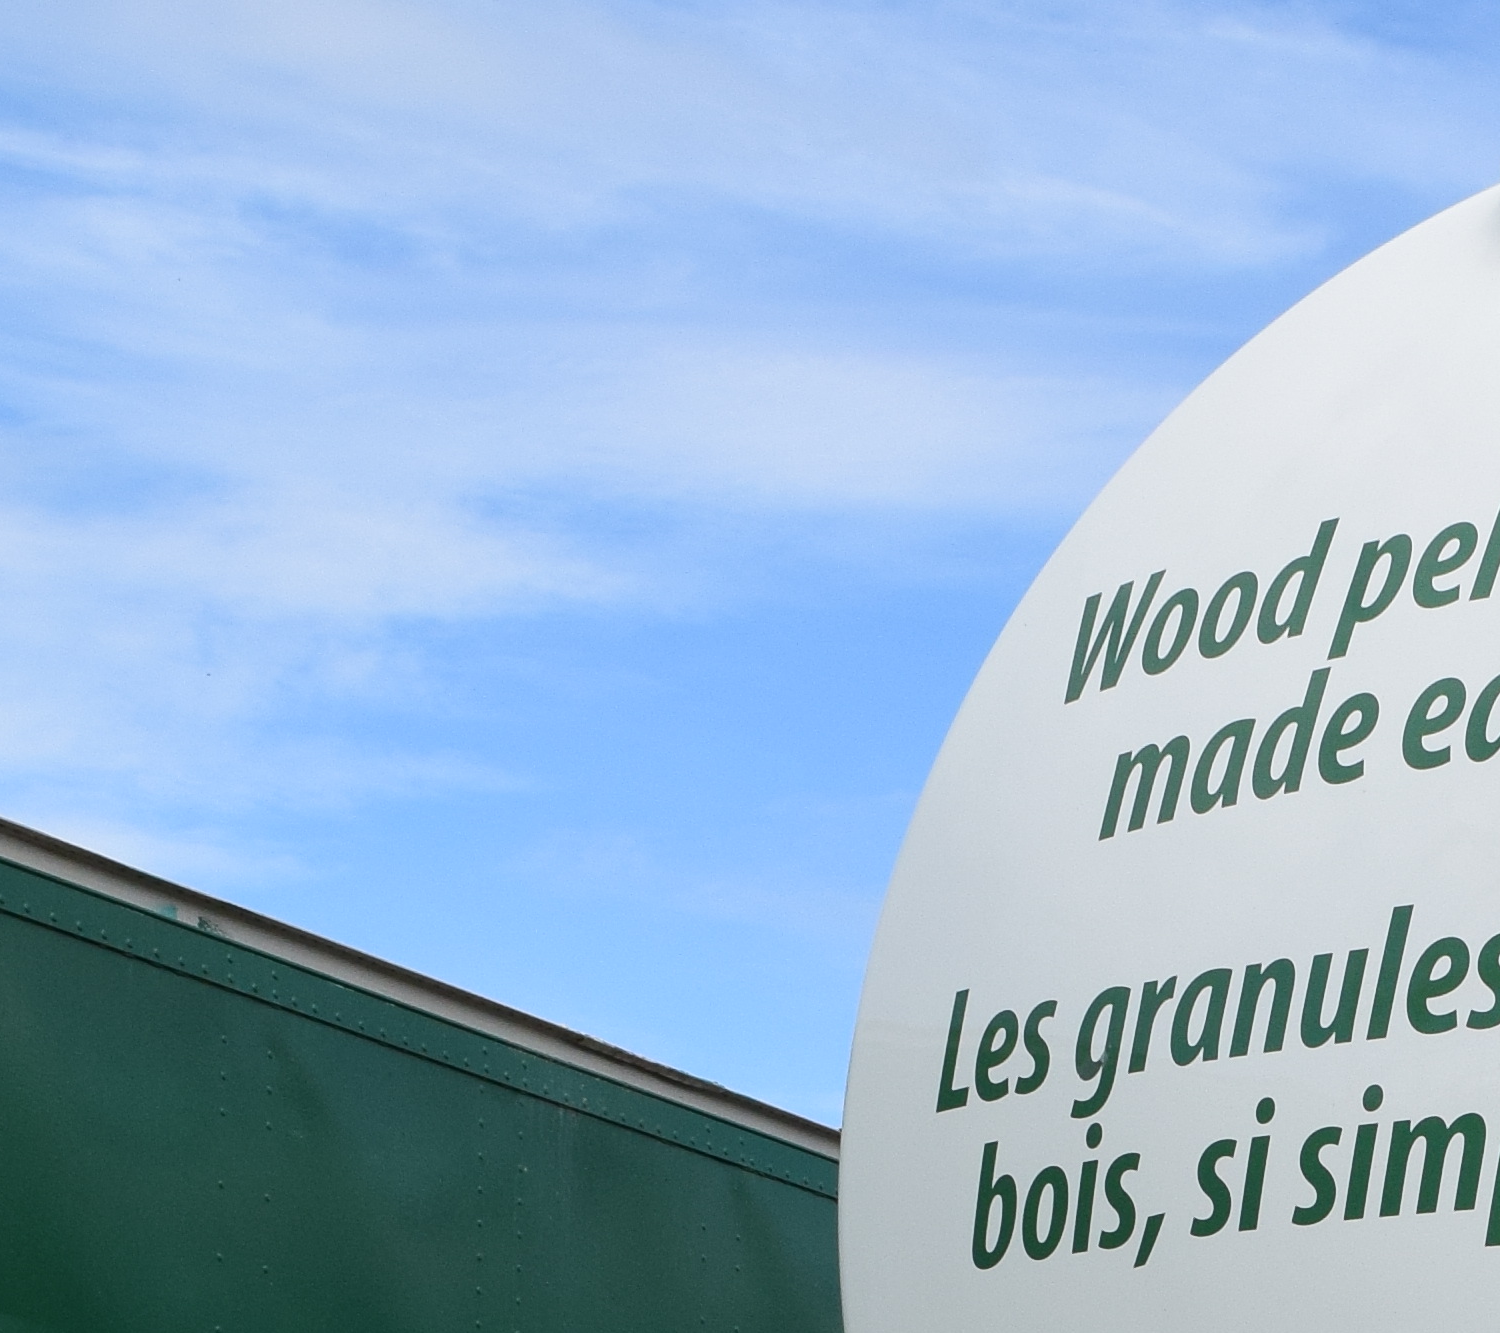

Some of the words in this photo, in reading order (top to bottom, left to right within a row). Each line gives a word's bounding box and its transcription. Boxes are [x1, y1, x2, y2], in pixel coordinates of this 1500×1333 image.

[1064, 518, 1340, 704] Wood
[1098, 668, 1379, 841] made
[936, 989, 1058, 1112] Les
[972, 1122, 1167, 1269] bois,
[1191, 1097, 1275, 1237] si
